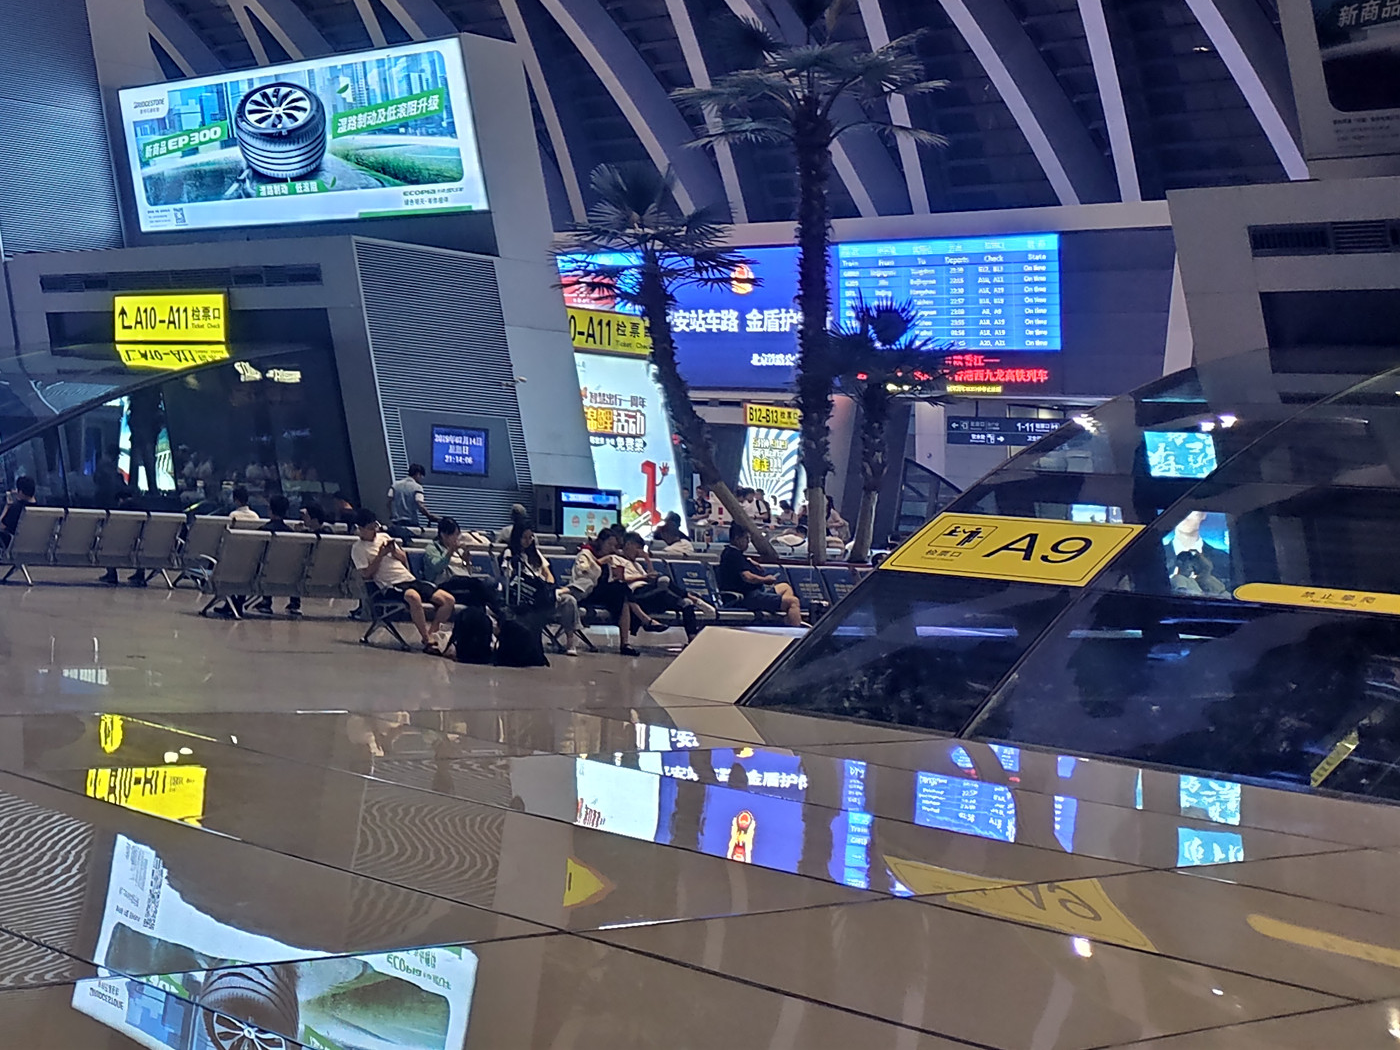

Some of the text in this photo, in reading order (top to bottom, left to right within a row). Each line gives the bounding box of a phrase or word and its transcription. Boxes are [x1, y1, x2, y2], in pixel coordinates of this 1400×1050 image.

[134, 305, 220, 330] A10-A11 检票口
[666, 309, 738, 332] 安站车路
[749, 407, 778, 423] B12-B13
[1017, 422, 1034, 432] 1-11
[925, 549, 962, 558] 检票口
[982, 532, 1092, 563] A9
